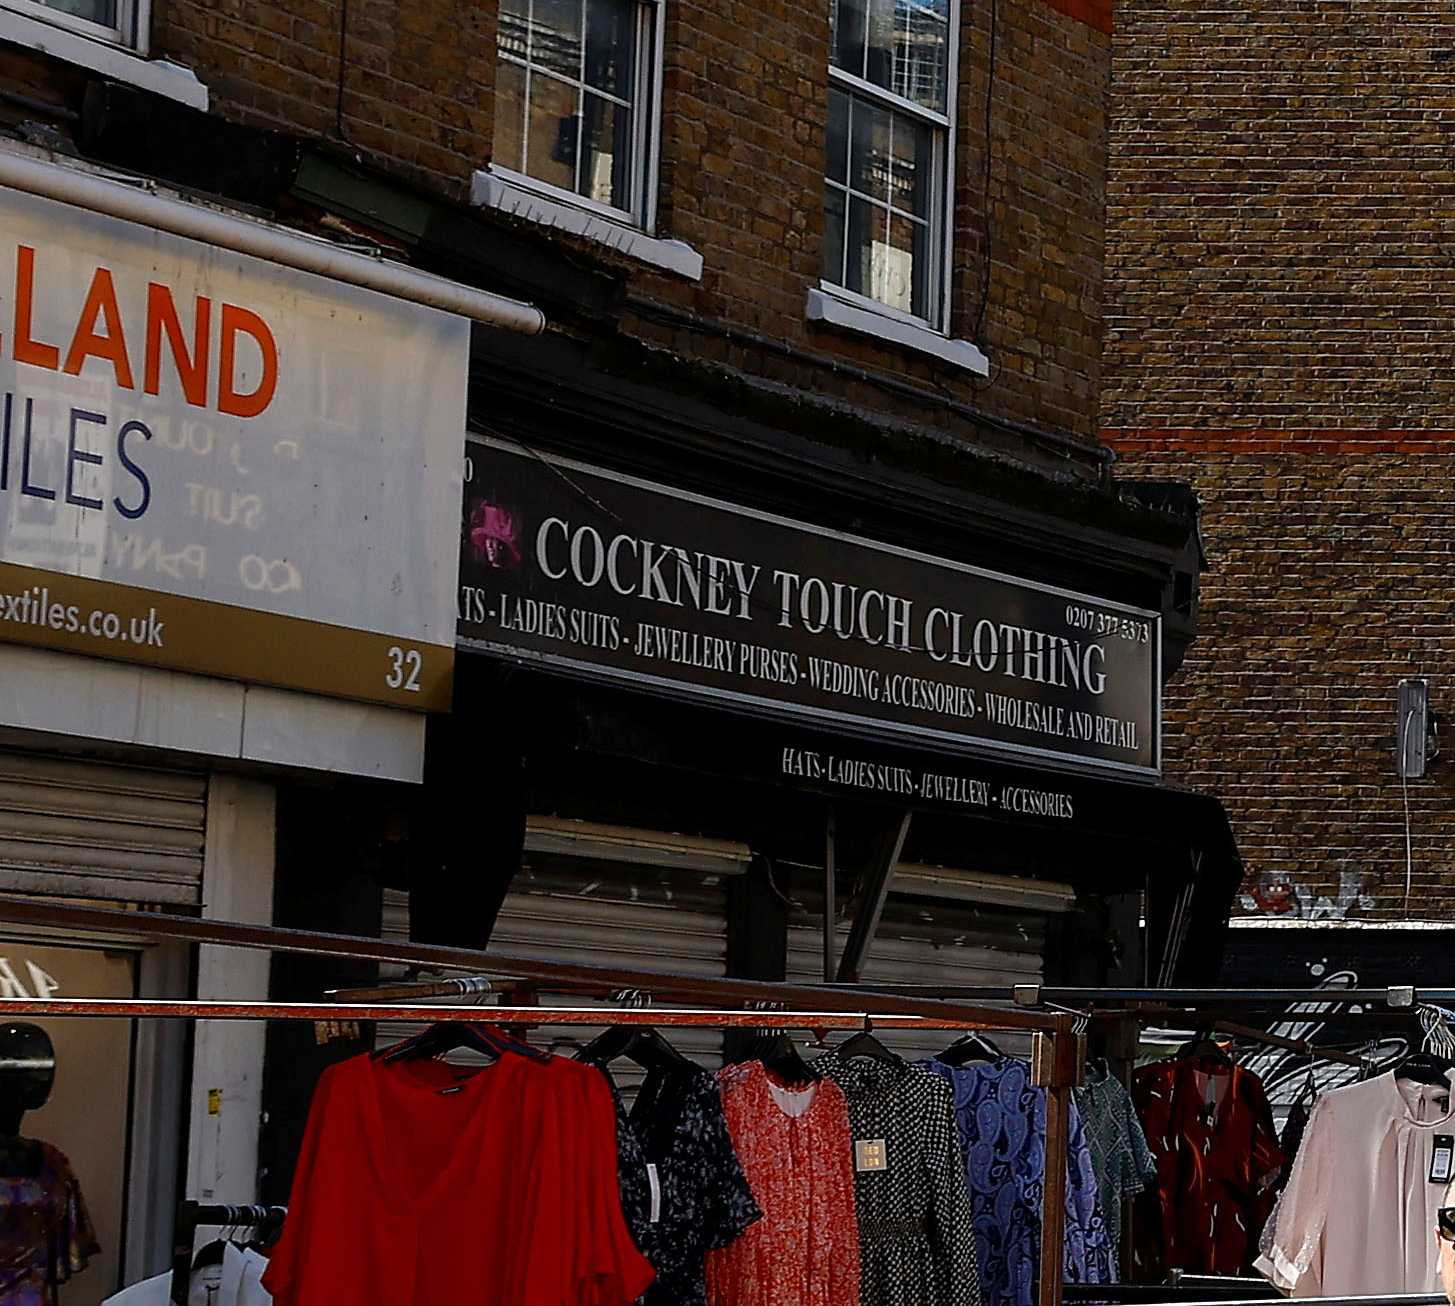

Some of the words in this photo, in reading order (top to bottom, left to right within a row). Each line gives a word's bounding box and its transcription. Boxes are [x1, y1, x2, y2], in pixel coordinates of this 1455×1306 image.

[0, 244, 279, 419] LAND
[535, 516, 762, 621] COCKNEY
[773, 570, 915, 654] TOUCH
[924, 605, 1107, 695] CLOTHING
[1066, 605, 1094, 629] 0207
[1097, 611, 1119, 635] 377
[385, 646, 424, 693] 32
[457, 585, 486, 625] TS
[500, 594, 567, 641] LADIES
[570, 608, 621, 652] SUITS
[634, 622, 736, 675] JEWELLERY
[740, 643, 798, 686] PURSES
[808, 656, 880, 702] WEDDING
[882, 671, 976, 719] ACCESSORIES
[984, 691, 1064, 737] WHOLESALE
[1066, 715, 1093, 742] AND
[1094, 716, 1139, 751] RETAIL
[782, 747, 821, 779] HATS
[828, 755, 876, 790] LADIES
[877, 765, 914, 795] SUITS
[919, 772, 991, 807] JEWELLERY
[999, 785, 1074, 819] ACCESSORIES
